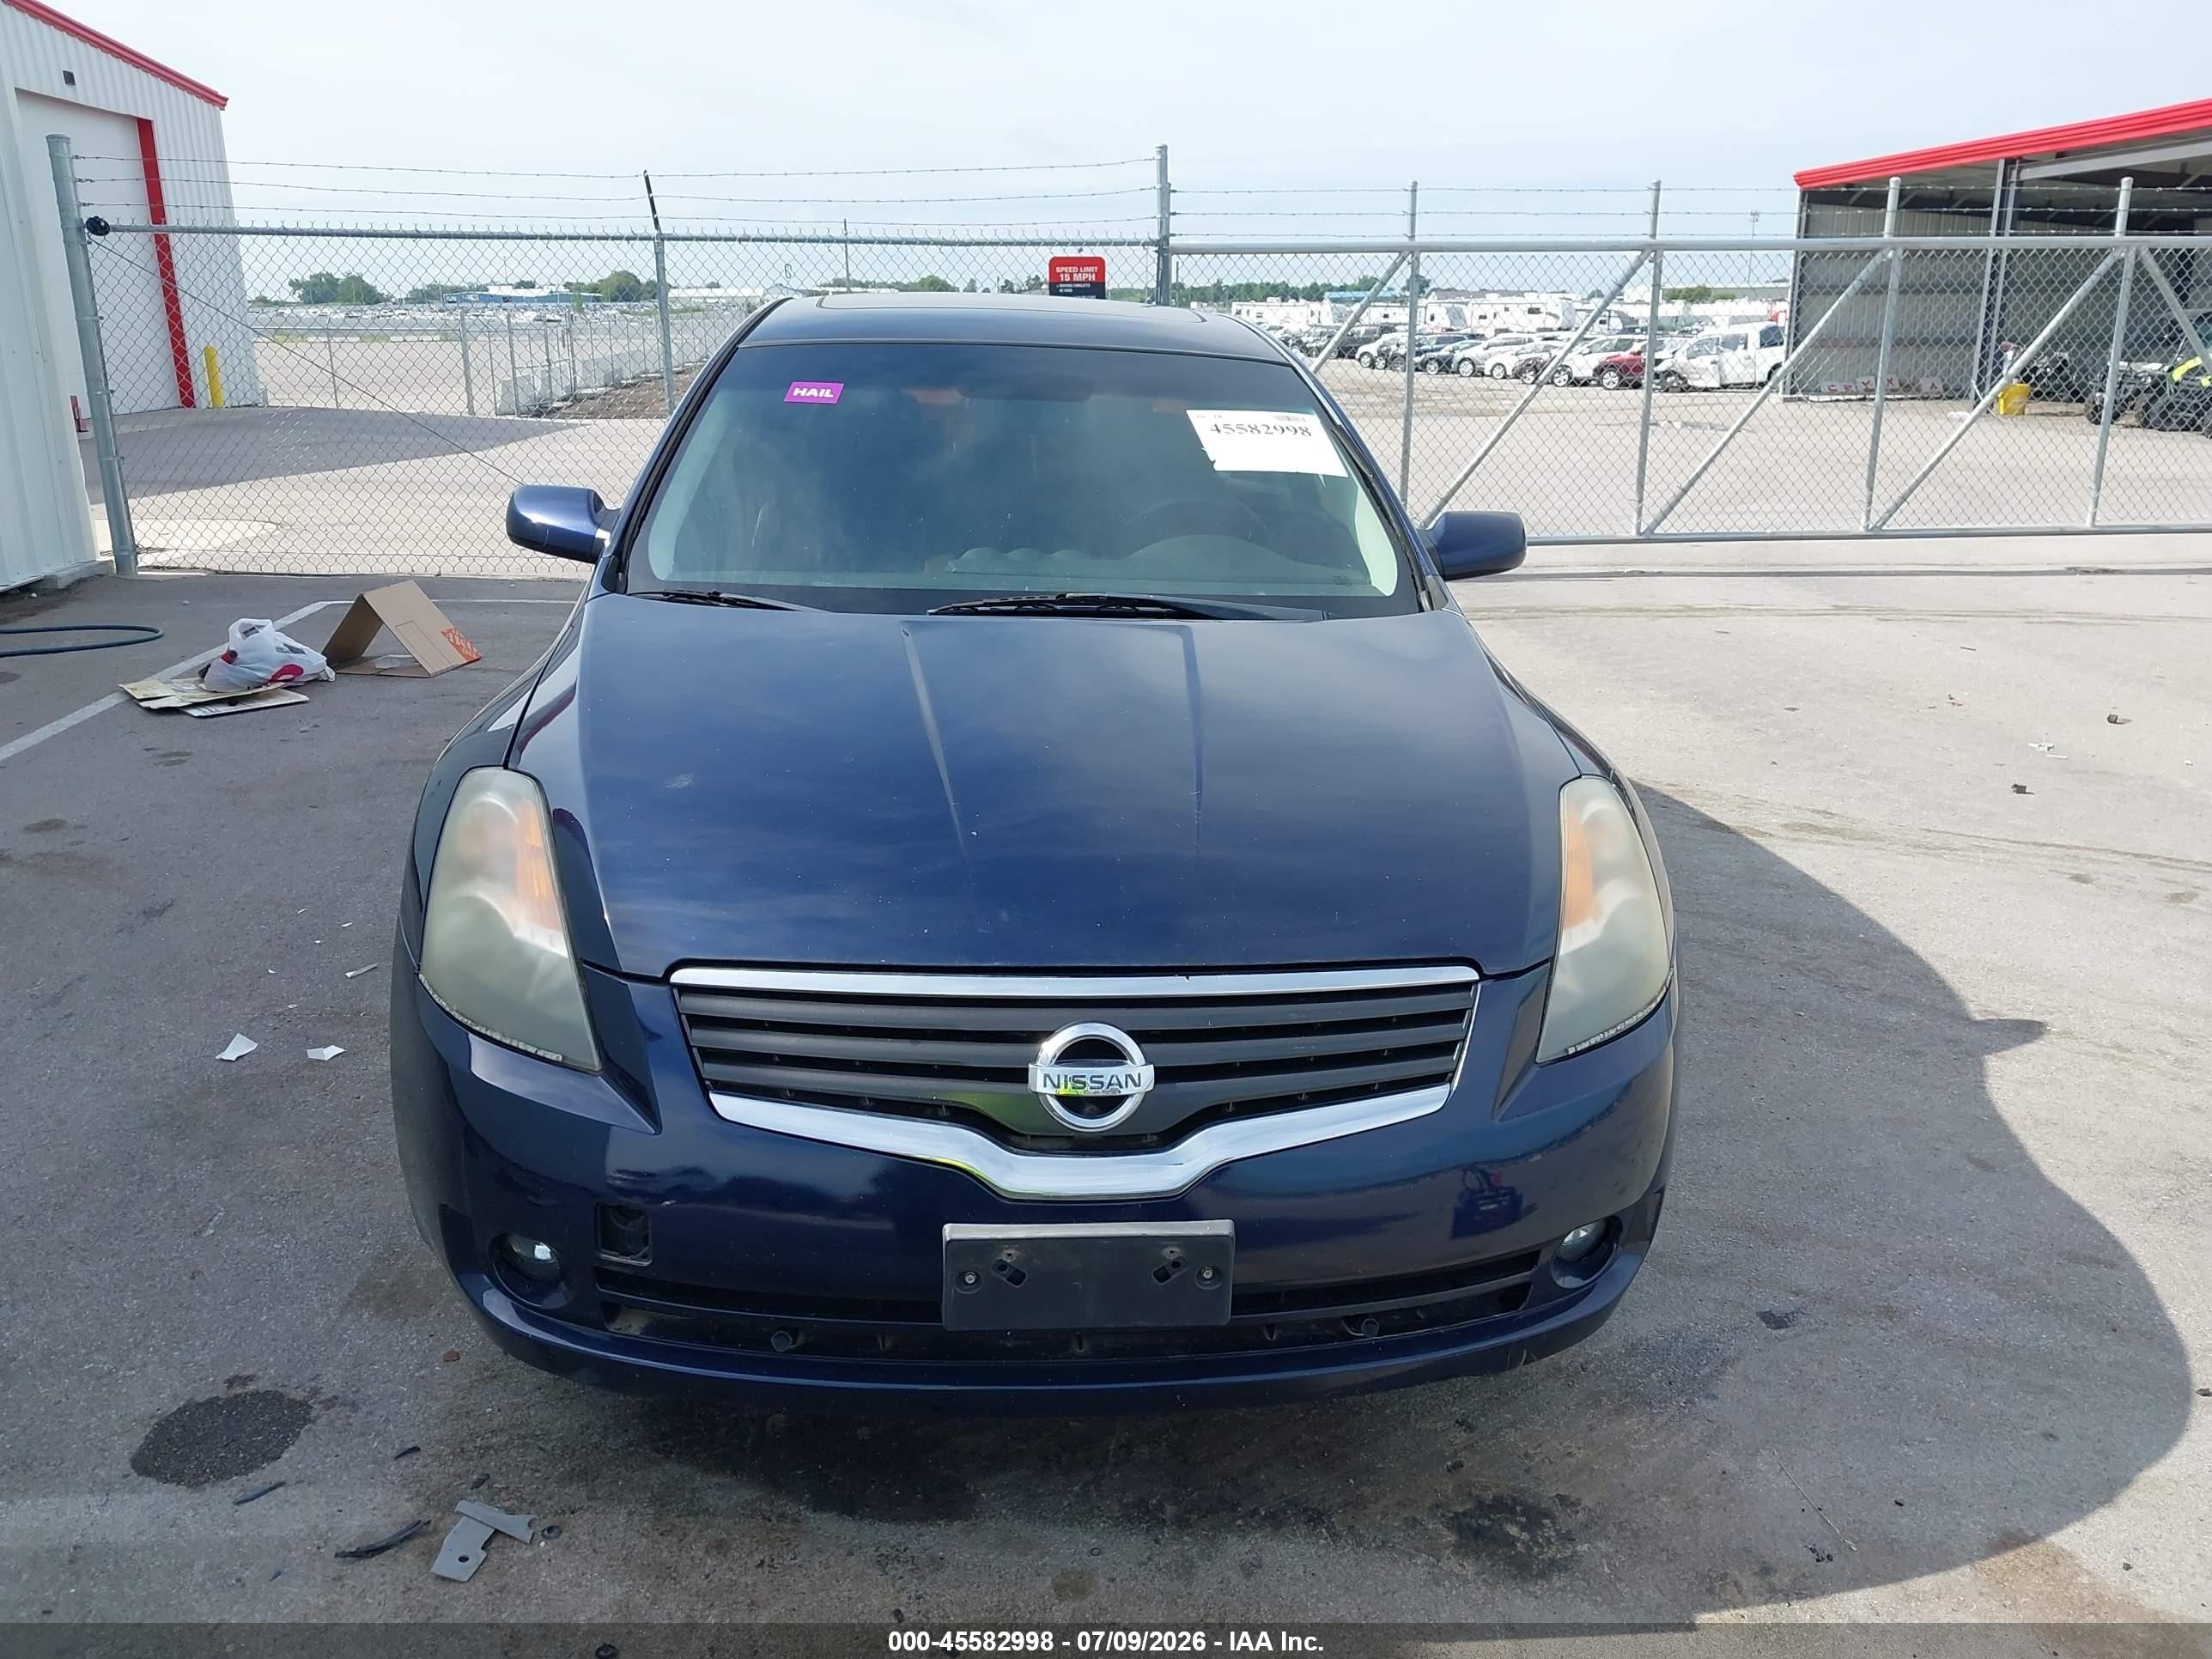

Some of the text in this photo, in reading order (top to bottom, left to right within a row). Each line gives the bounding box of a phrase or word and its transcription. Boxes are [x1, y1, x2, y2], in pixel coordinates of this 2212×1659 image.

[1060, 273, 1096, 282] 15 MPH
[793, 387, 835, 398] HAIL
[1210, 423, 1312, 437] 45582998
[1043, 1073, 1141, 1091] NISSAN
